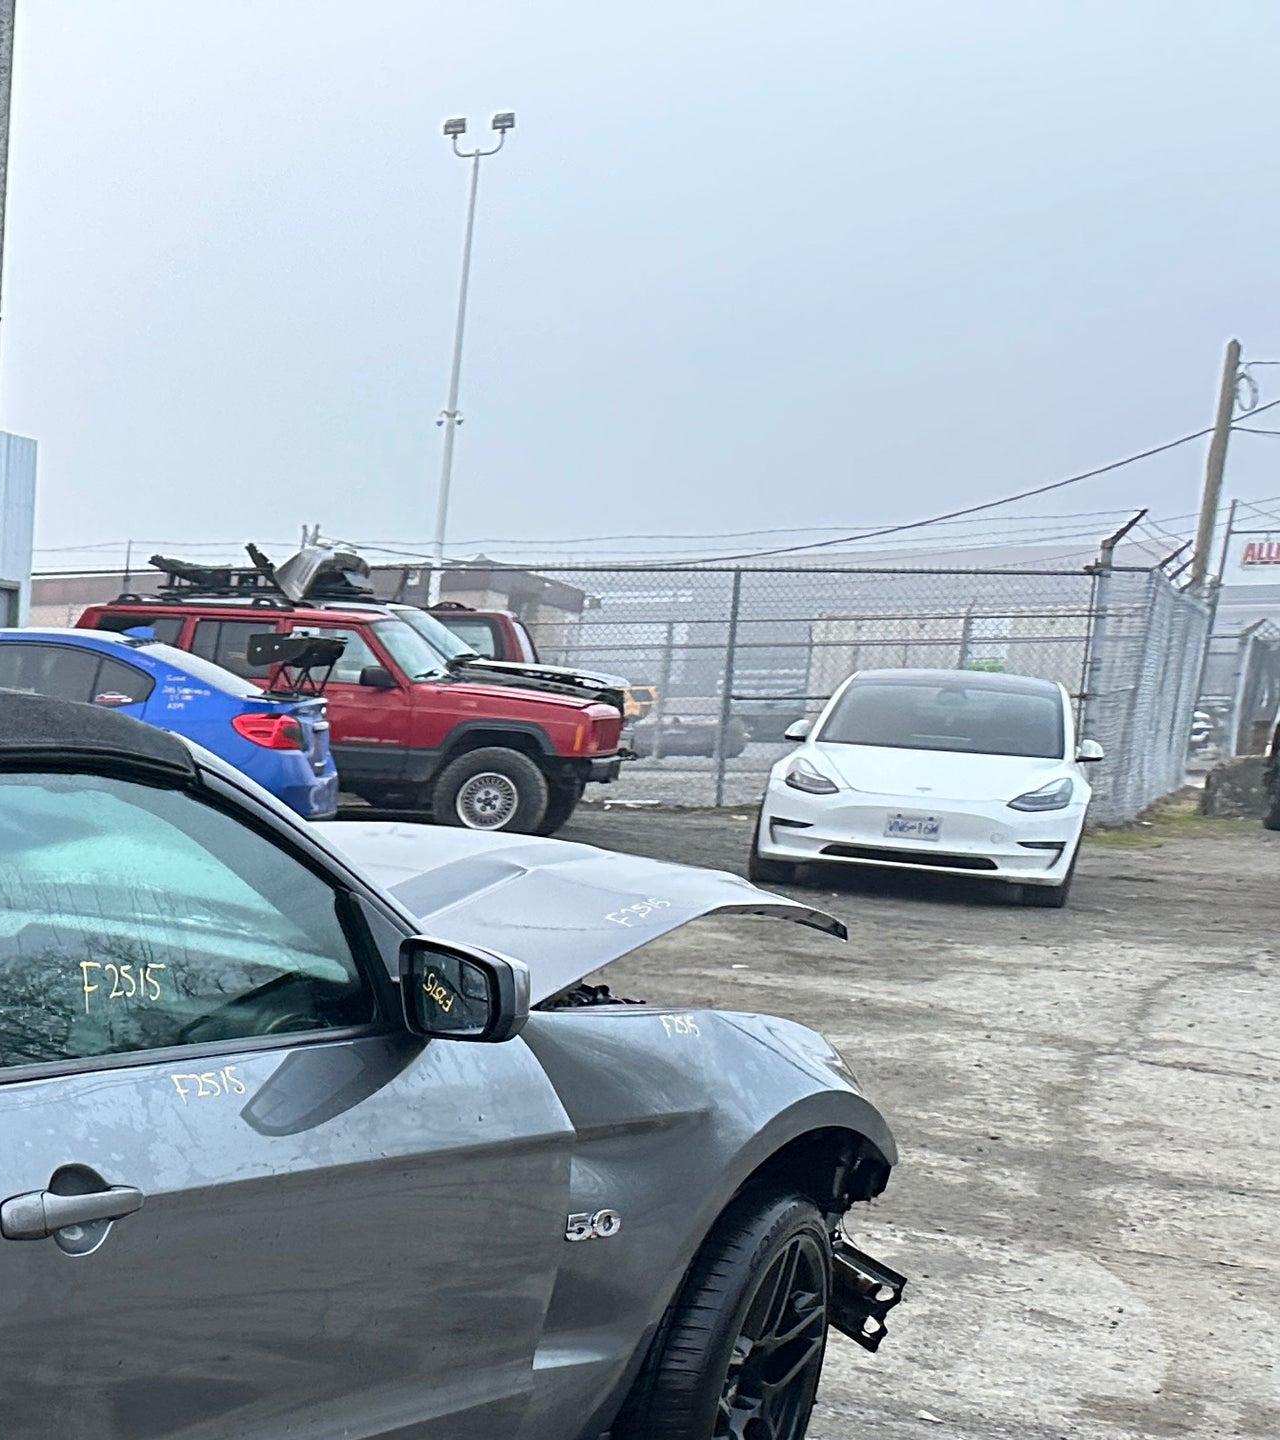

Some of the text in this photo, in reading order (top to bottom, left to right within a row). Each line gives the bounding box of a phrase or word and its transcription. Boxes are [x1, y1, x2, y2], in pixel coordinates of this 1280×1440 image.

[604, 896, 673, 929] F2515
[79, 959, 167, 1014] F2515
[658, 1013, 701, 1040] F2515
[171, 1066, 246, 1106] F2515
[565, 1208, 621, 1241] 5.0
